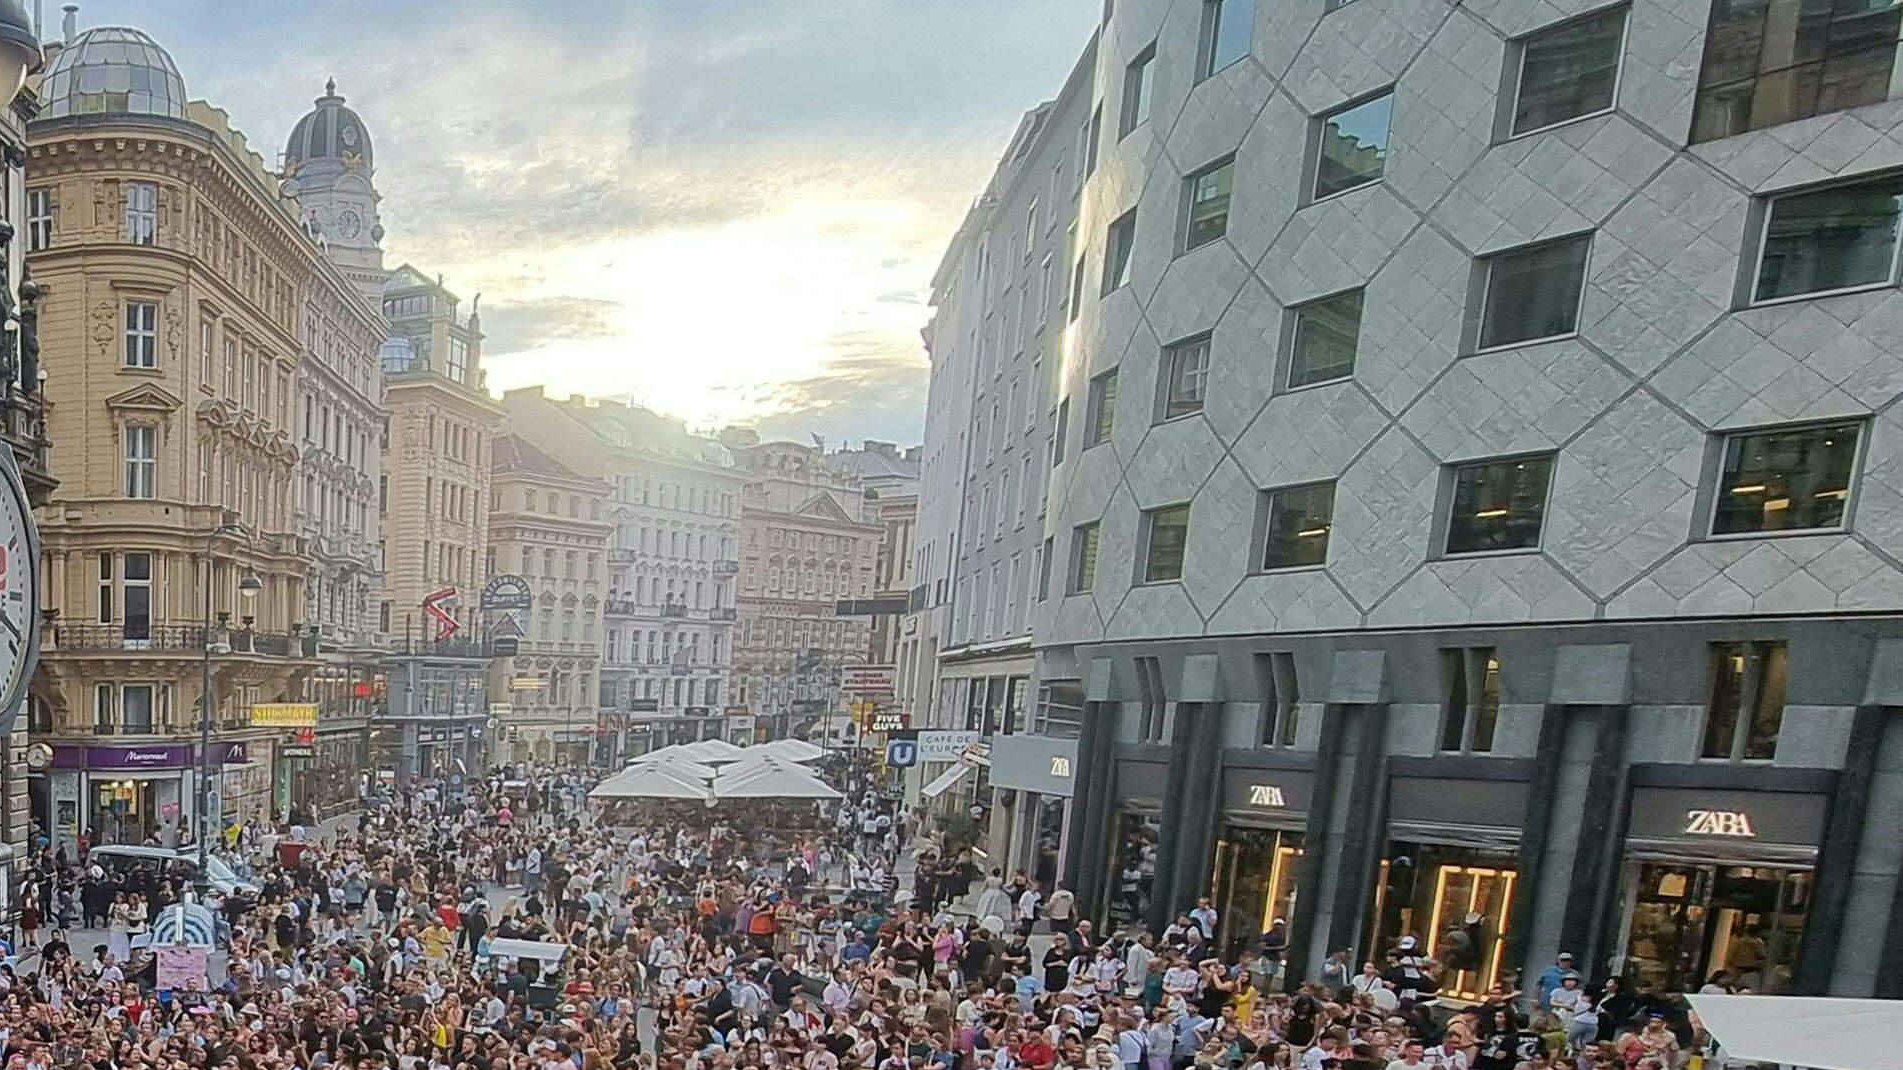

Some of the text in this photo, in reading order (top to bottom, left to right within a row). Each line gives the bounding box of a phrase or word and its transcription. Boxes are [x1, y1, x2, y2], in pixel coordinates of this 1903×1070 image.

[876, 714, 901, 722] FIVE
[926, 735, 971, 743] CAFÉ DE
[894, 746, 913, 764] U
[1250, 785, 1286, 806] ZARA
[1685, 810, 1757, 837] ZARA
